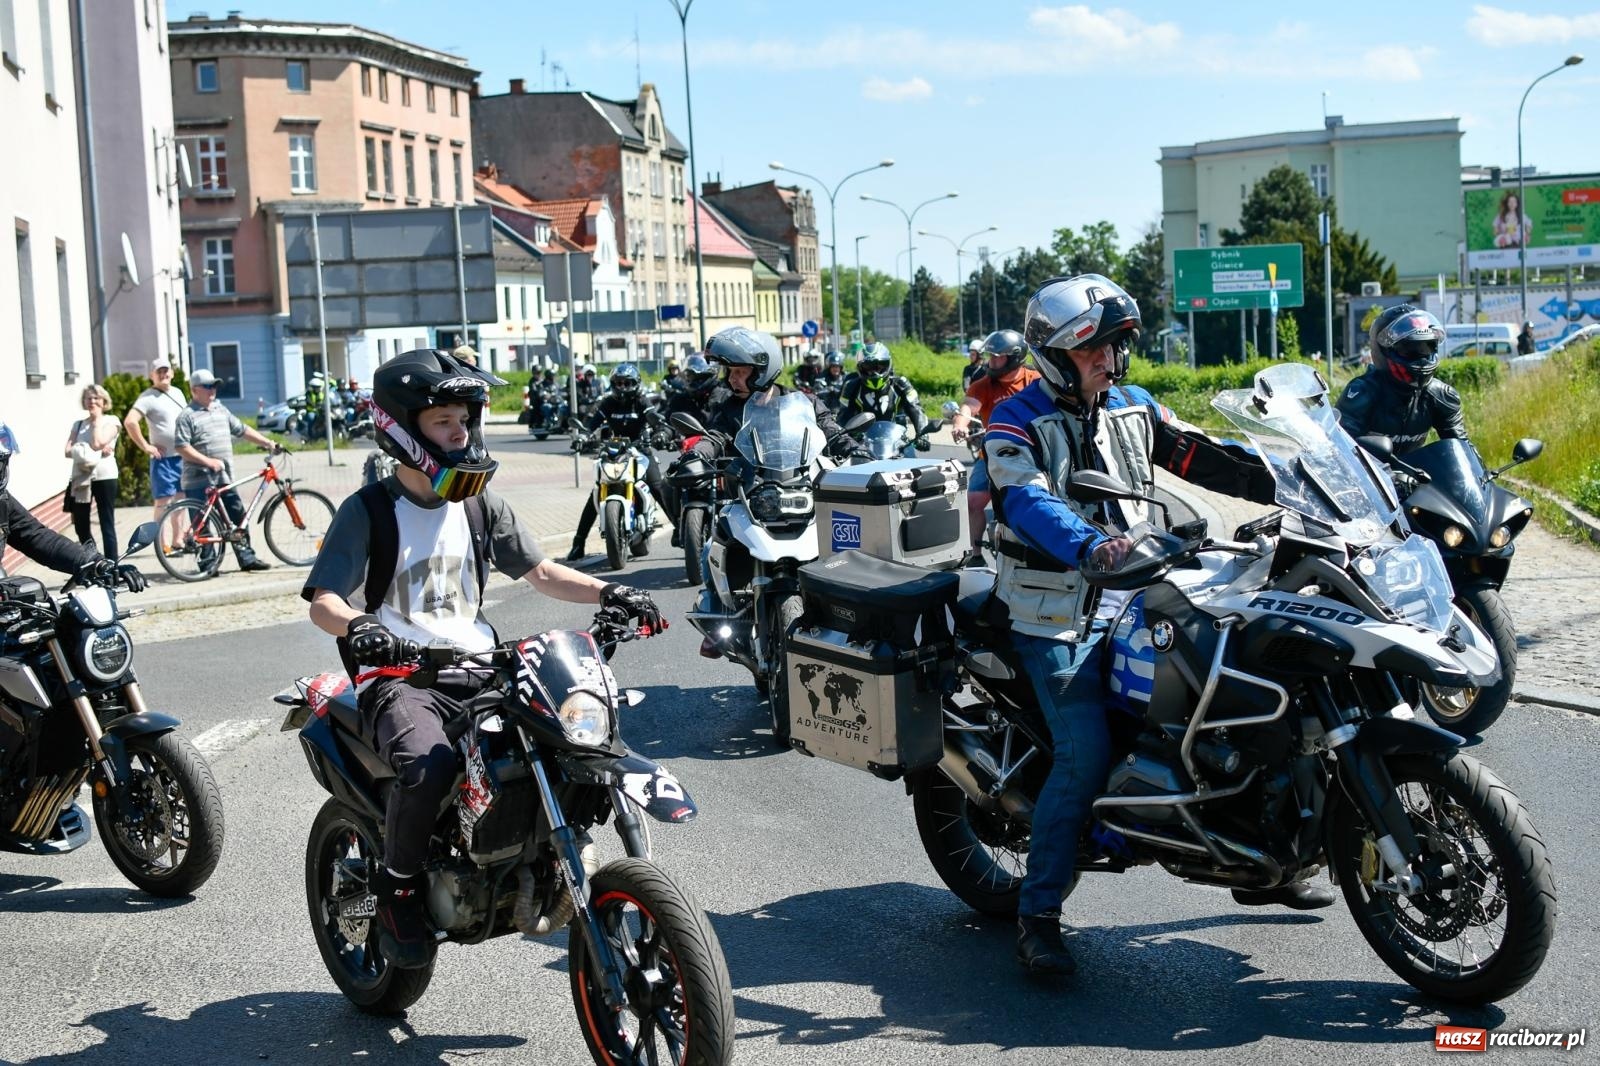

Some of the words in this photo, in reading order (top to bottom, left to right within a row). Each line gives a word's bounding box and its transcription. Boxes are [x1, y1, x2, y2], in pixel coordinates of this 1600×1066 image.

[1211, 250, 1240, 259] Rybnik
[1211, 261, 1244, 270] Gliwice
[1212, 298, 1240, 307] Opole
[426, 596, 442, 604] USA
[1247, 597, 1366, 625] R1200
[796, 716, 869, 744] ADVENTURE
